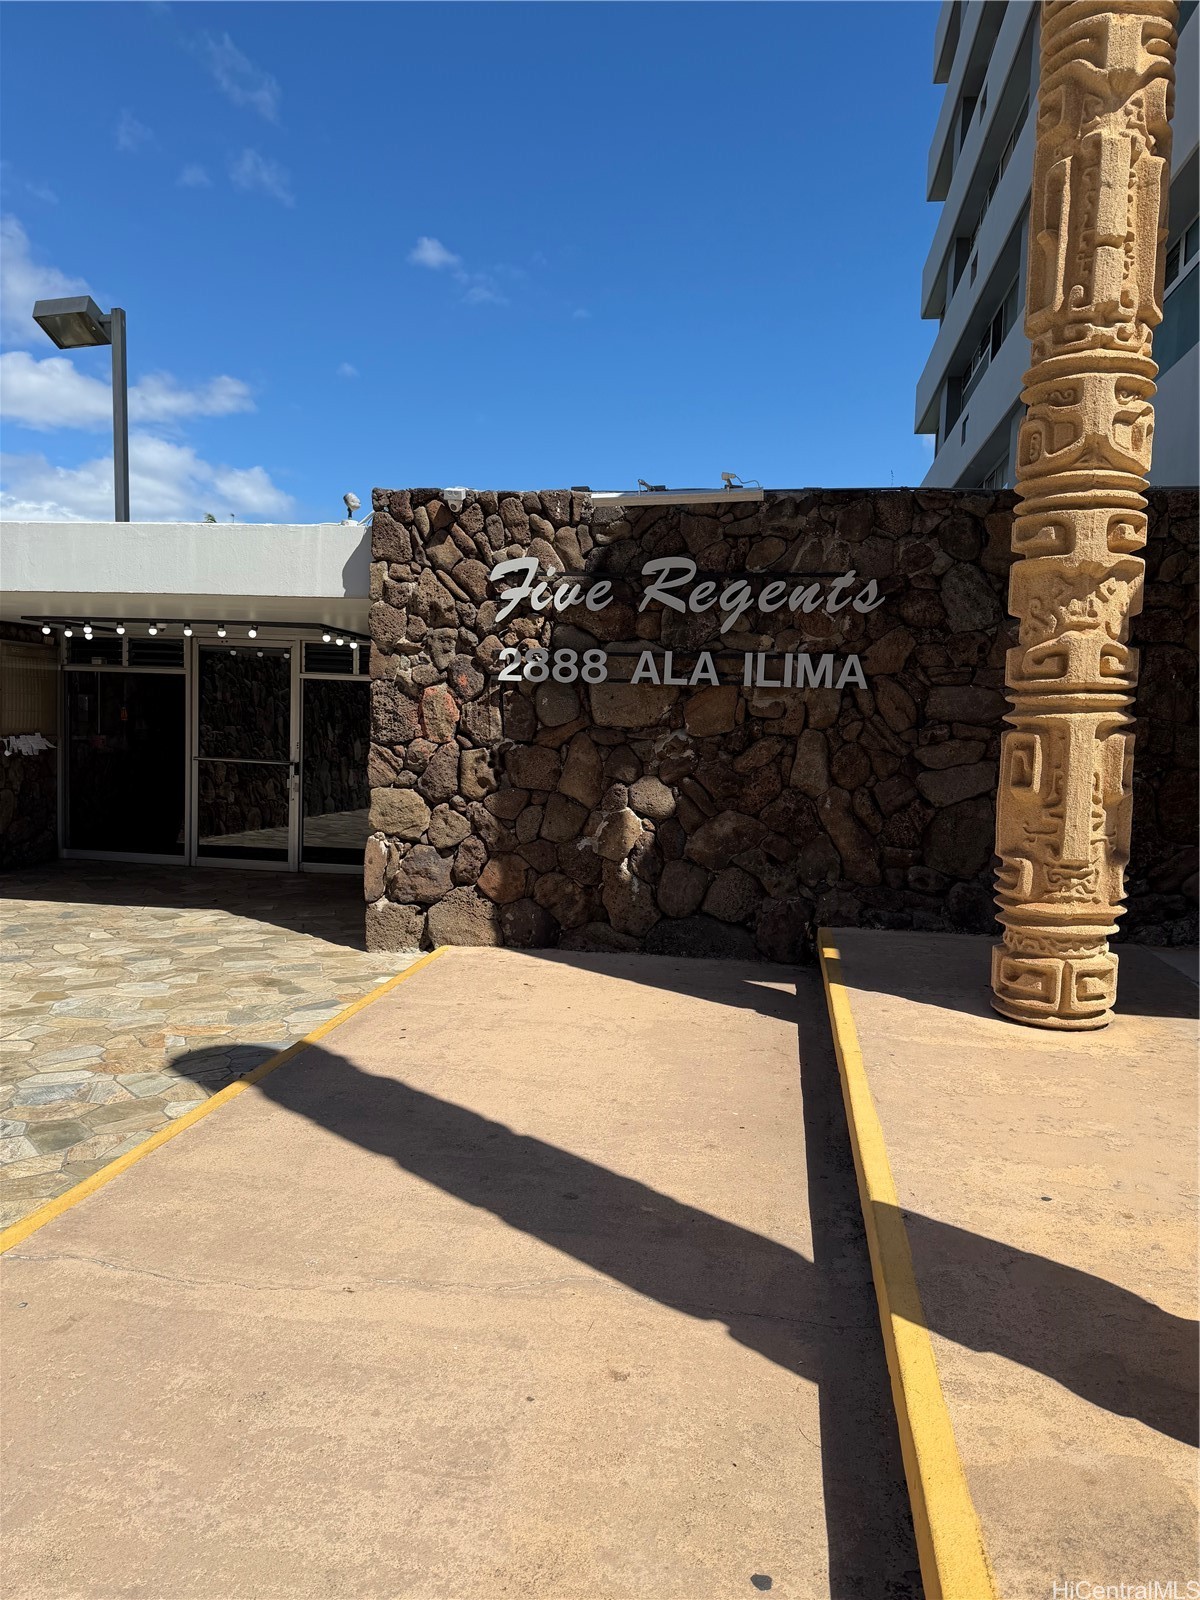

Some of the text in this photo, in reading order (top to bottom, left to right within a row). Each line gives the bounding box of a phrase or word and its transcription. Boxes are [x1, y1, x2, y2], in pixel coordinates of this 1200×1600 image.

[490, 556, 886, 634] Five Regents
[498, 648, 868, 689] 2888 ALA ILIMA
